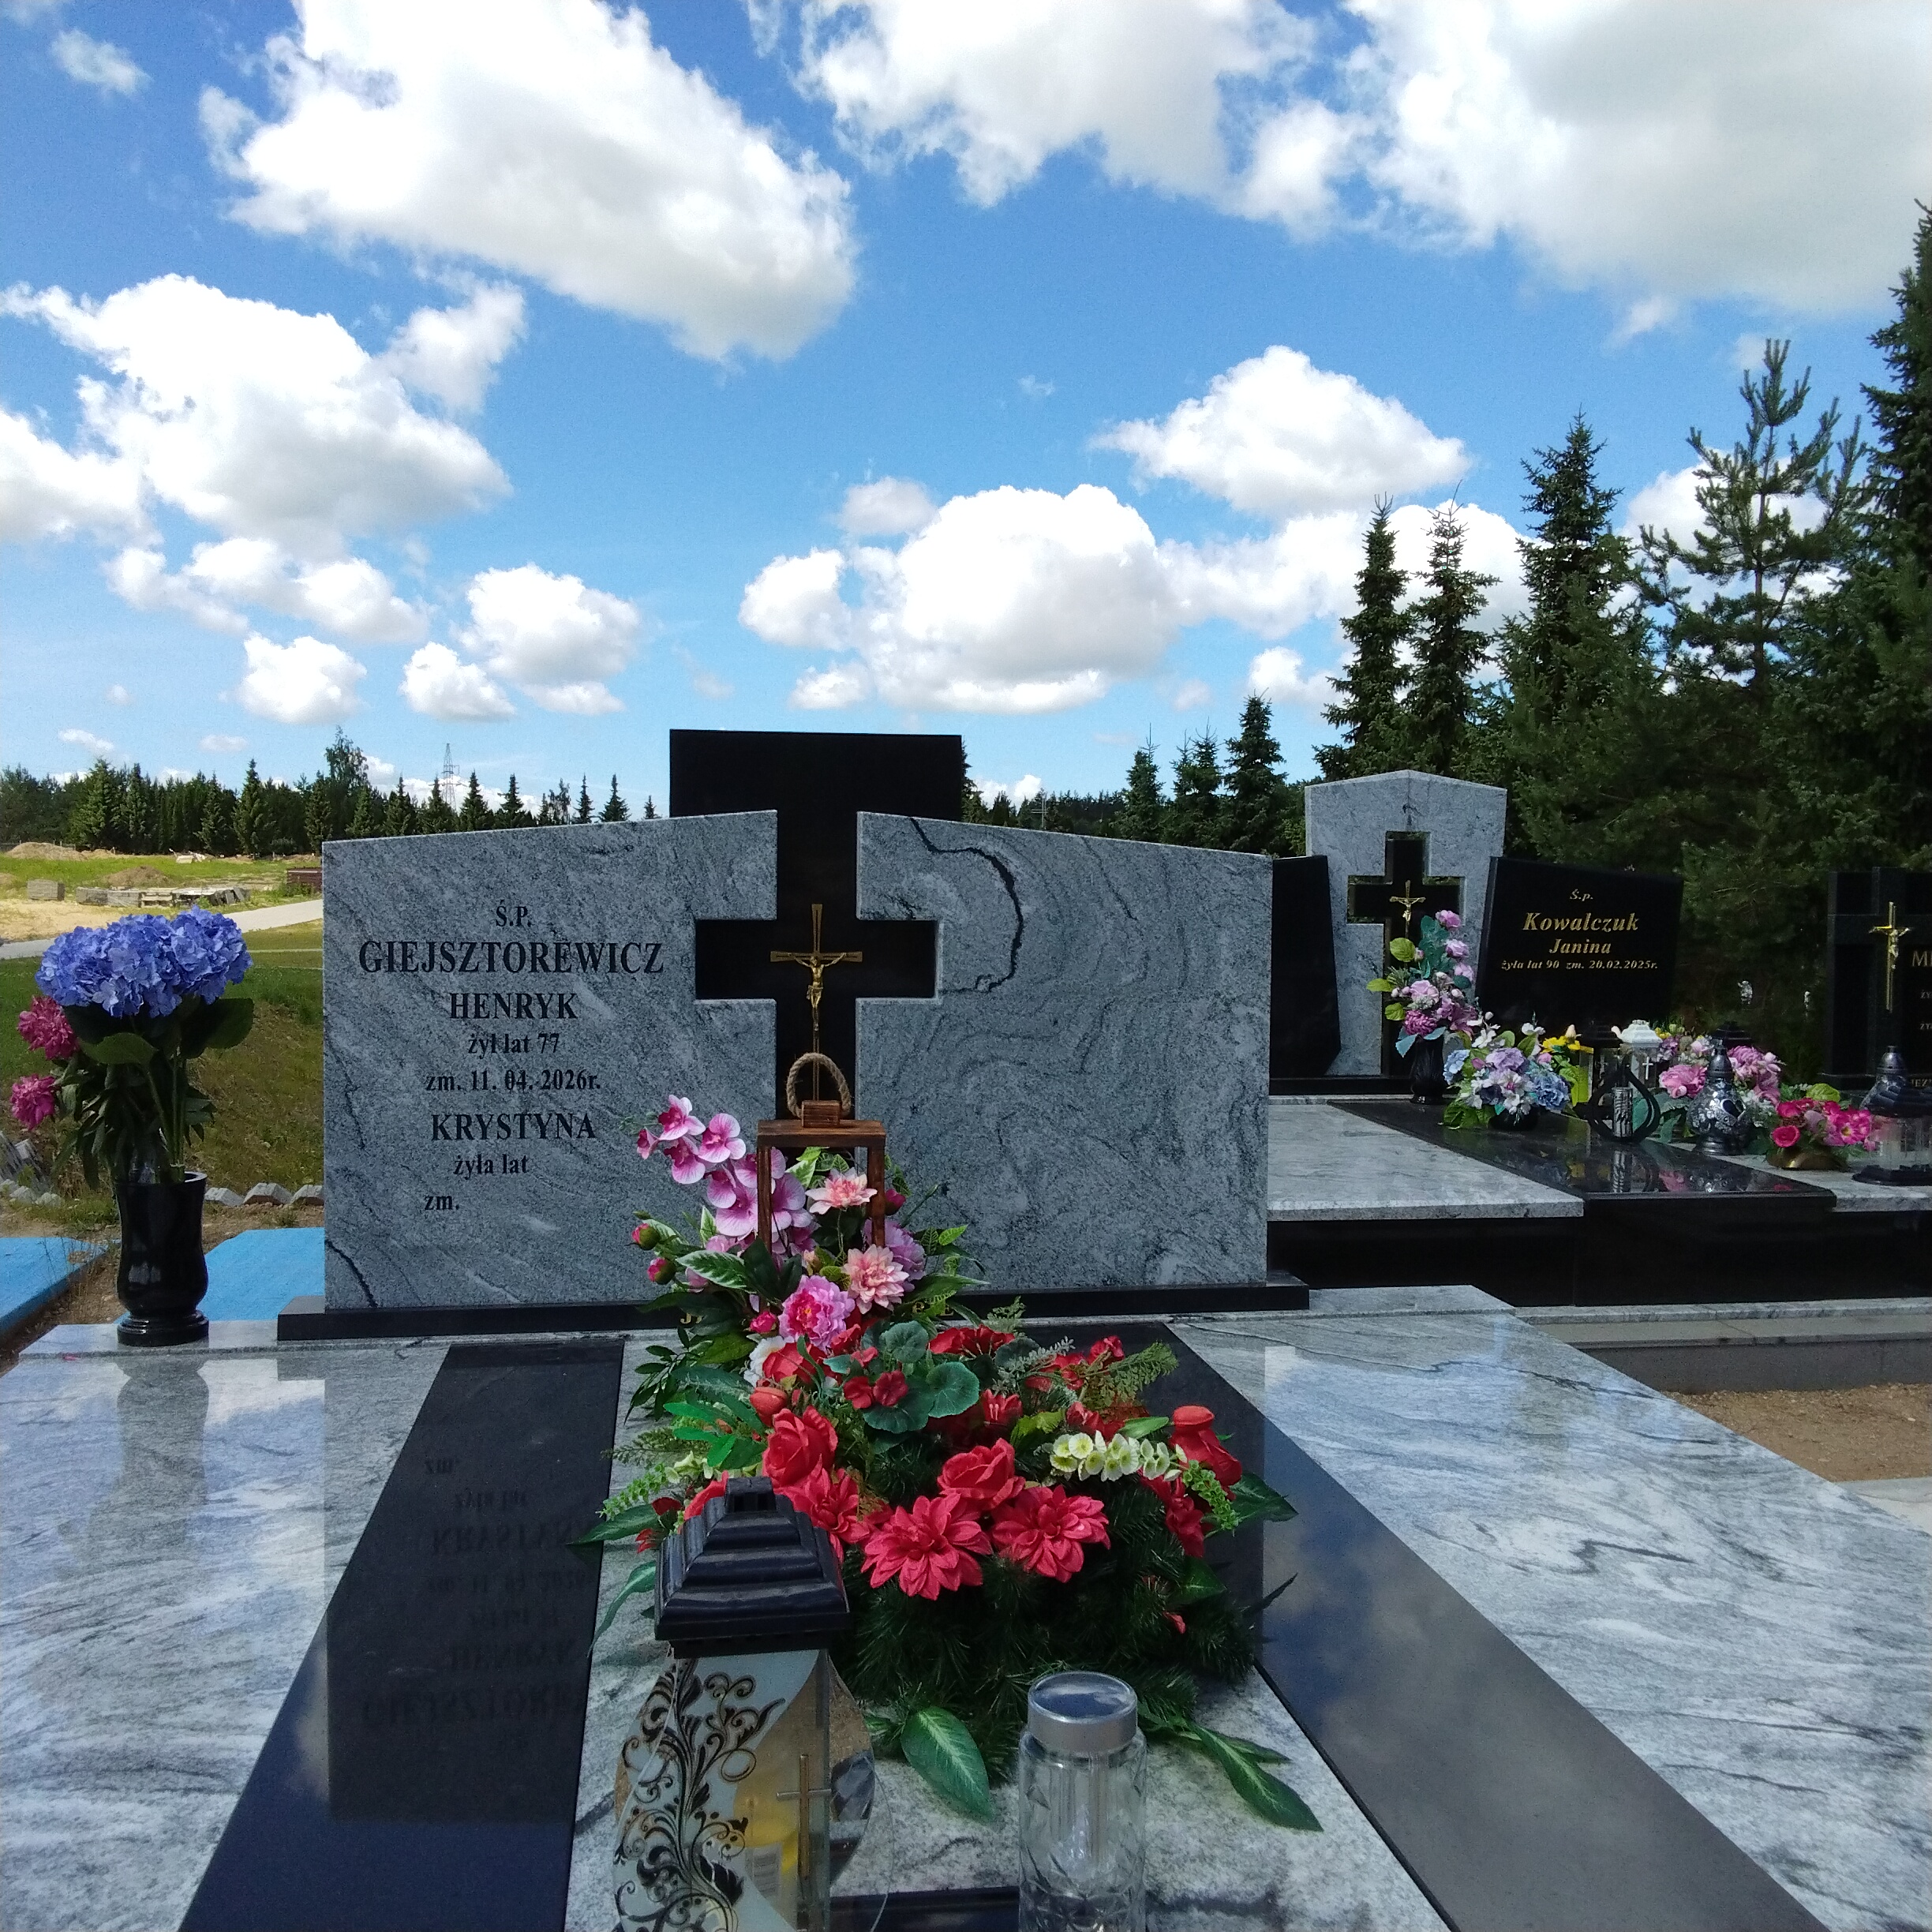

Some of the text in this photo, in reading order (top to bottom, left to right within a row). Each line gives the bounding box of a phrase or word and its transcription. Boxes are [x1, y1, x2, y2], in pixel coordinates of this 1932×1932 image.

[495, 900, 532, 927] Ś.P.
[1522, 912, 1639, 932] Kowalczuk
[359, 941, 664, 973] GIEJSZTOREWICZ
[1548, 938, 1612, 954] Janina
[1527, 960, 1542, 969] lat
[1546, 960, 1559, 969] 90
[1589, 960, 1658, 969] 20.02.2025r.
[449, 993, 578, 1019] HENRYK
[468, 1033, 560, 1058] żył lat 77
[425, 1069, 601, 1091] zm. 11. 04. 2026r.
[432, 1114, 596, 1140] KRYSTYNA
[452, 1153, 529, 1178] żyła lat
[424, 1194, 460, 1211] zm.
